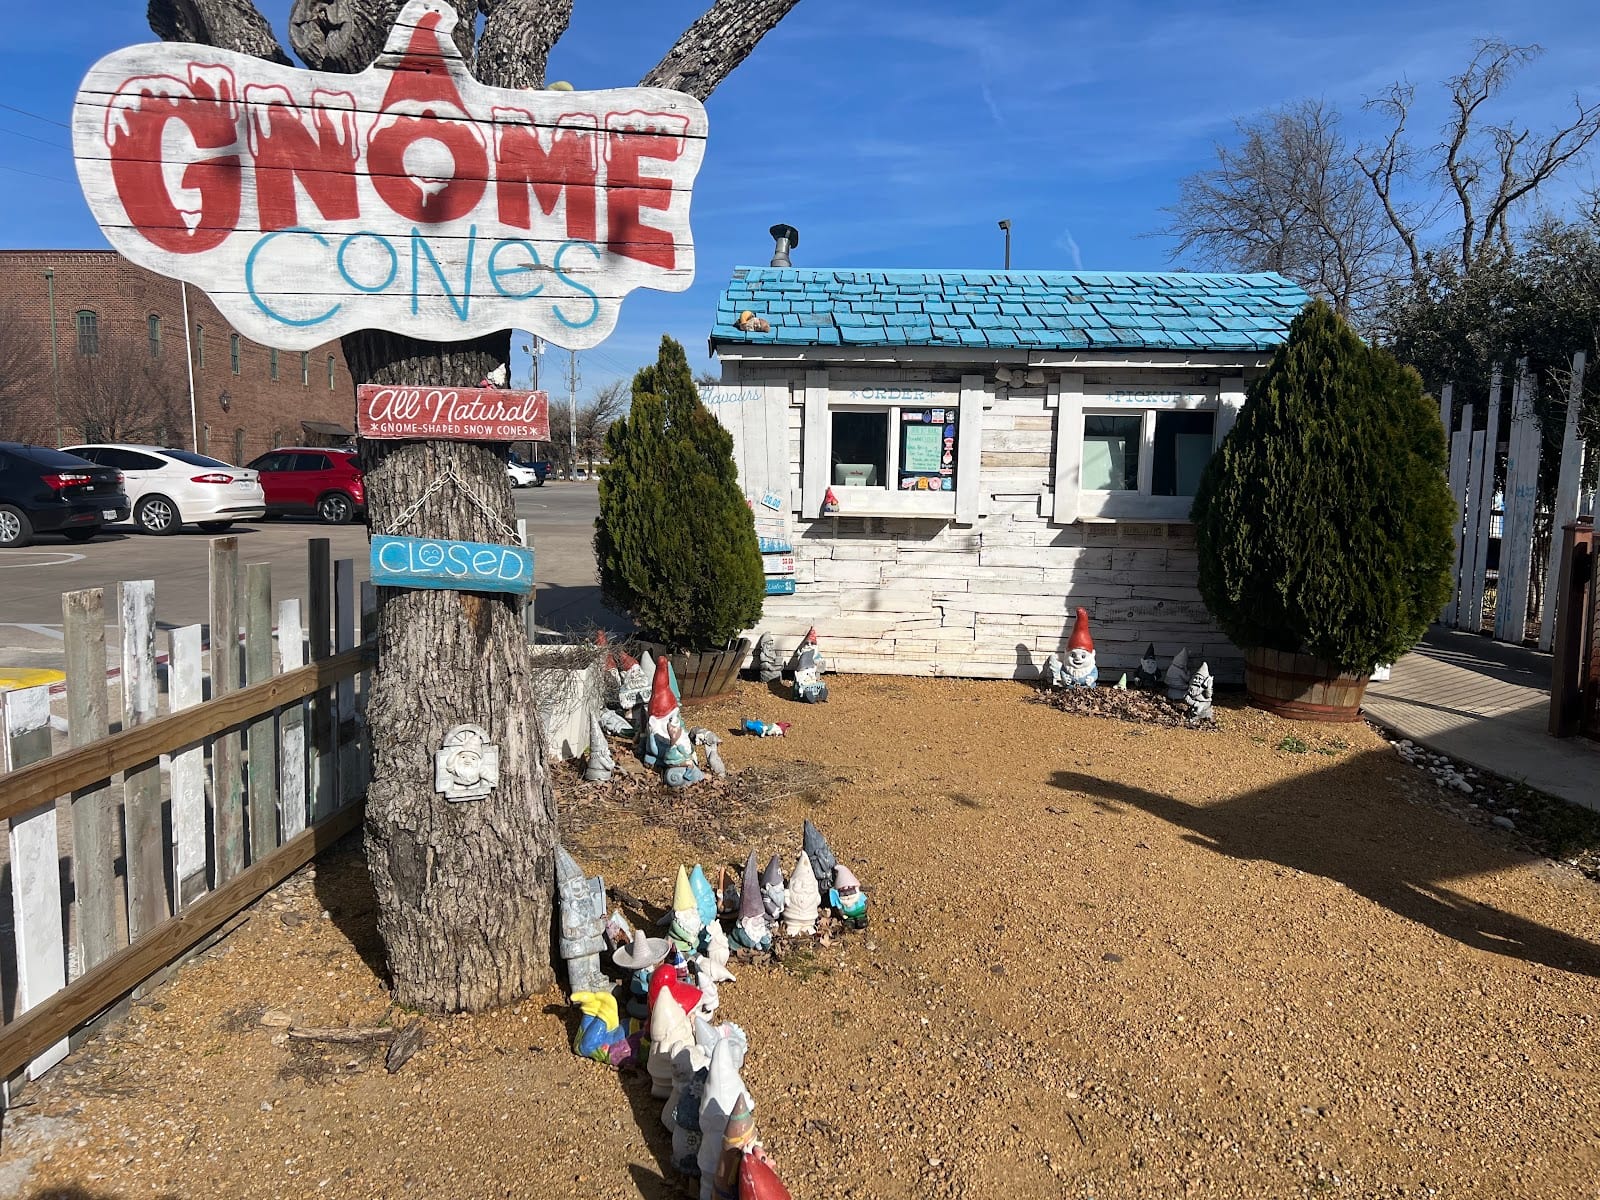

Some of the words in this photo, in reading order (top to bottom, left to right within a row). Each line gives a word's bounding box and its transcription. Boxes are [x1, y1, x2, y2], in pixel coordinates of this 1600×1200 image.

[105, 62, 690, 270] GNOME
[244, 223, 602, 330] CoNeS
[368, 389, 421, 421] All
[425, 390, 538, 423] Natural
[861, 387, 925, 400] ORDER
[1115, 390, 1183, 403] PICKUP
[380, 422, 460, 434] GNOME-SHAPED
[463, 423, 493, 435] SNOW
[497, 425, 528, 436] CONES
[378, 541, 524, 580] CLOSeD
